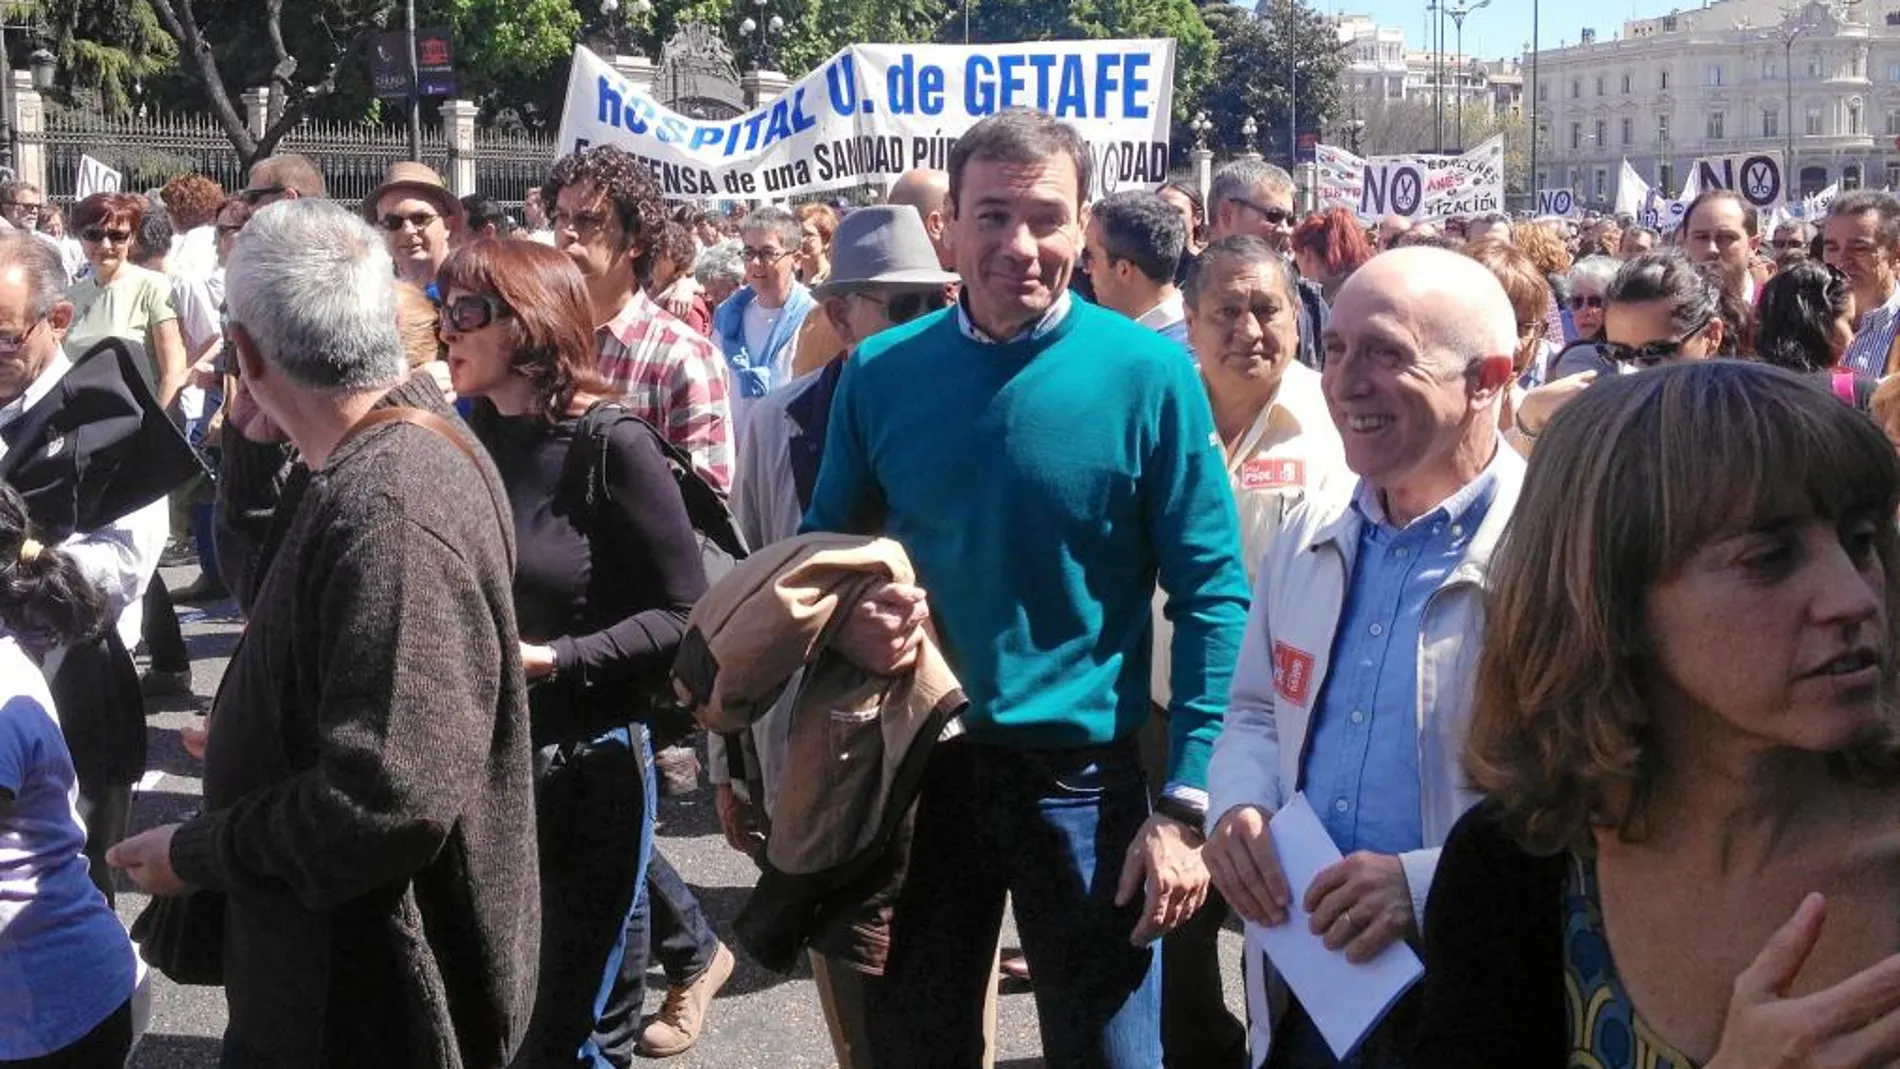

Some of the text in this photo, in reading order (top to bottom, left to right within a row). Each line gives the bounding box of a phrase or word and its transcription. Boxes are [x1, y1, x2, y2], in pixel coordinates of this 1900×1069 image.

[826, 53, 874, 117] U.
[887, 53, 944, 116] de
[964, 52, 1150, 119] GETAFE
[80, 159, 118, 197] NO
[724, 169, 756, 194] de
[763, 159, 812, 192] una
[1360, 165, 1421, 216] NO
[1700, 155, 1780, 206] NO
[1538, 191, 1571, 215] NO
